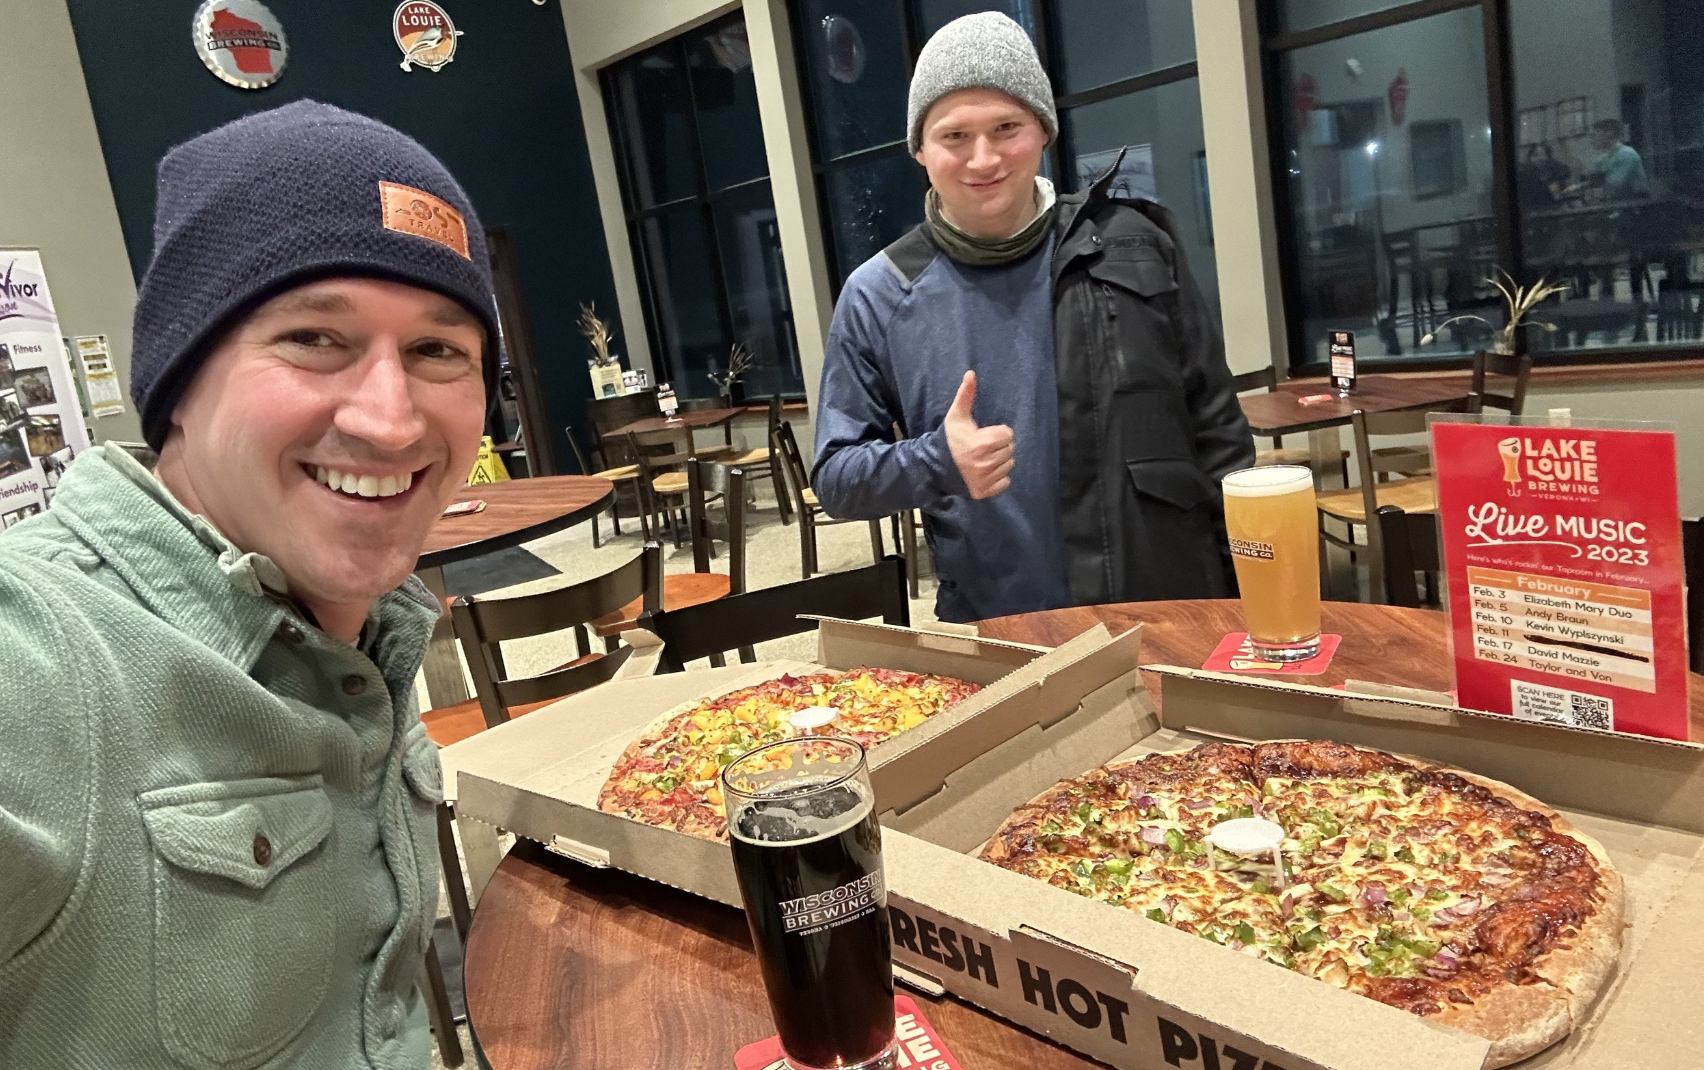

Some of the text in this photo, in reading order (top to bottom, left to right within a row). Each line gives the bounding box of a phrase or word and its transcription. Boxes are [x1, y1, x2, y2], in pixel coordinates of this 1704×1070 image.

[401, 15, 443, 26] LOUIE
[205, 29, 278, 41] WISCONSIN
[209, 39, 267, 50] BREWING
[409, 218, 454, 242] TRAVEL
[13, 344, 43, 355] Fitness
[1524, 437, 1598, 462] LAKE
[1526, 457, 1599, 483] LOUIE
[0, 481, 39, 500] riendship
[1528, 481, 1600, 496] BREWING
[1465, 502, 1647, 545] Live MUSIC
[1229, 538, 1273, 551] CONSIN
[1587, 544, 1649, 566] 2023
[1467, 554, 1490, 563] Here's
[1492, 558, 1514, 567] who's
[1557, 565, 1593, 577] Taproom
[1517, 575, 1592, 598] February
[1473, 586, 1633, 619] Feb. 3 Elizabeth Mary Duo
[1474, 599, 1589, 626] Feb. 5 Andy Braun
[1476, 611, 1497, 623] Feb.
[1500, 616, 1513, 625] 10
[1526, 620, 1555, 634] Kevin
[1477, 624, 1510, 637] Feb. 11
[1478, 636, 1600, 667] Feb. 17 David Mazzie
[1478, 649, 1613, 682] Feb. 24 Taylor and Von
[1517, 685, 1565, 701] SCAN HERE
[1530, 696, 1547, 704] view
[1524, 708, 1559, 719] of even
[1532, 703, 1565, 714] calendar
[778, 868, 882, 915] WISCONSIN
[785, 893, 869, 930] BREWING
[887, 904, 999, 989] RESH
[1016, 957, 1130, 1045] HOT
[1156, 1015, 1287, 1070] PIZ
